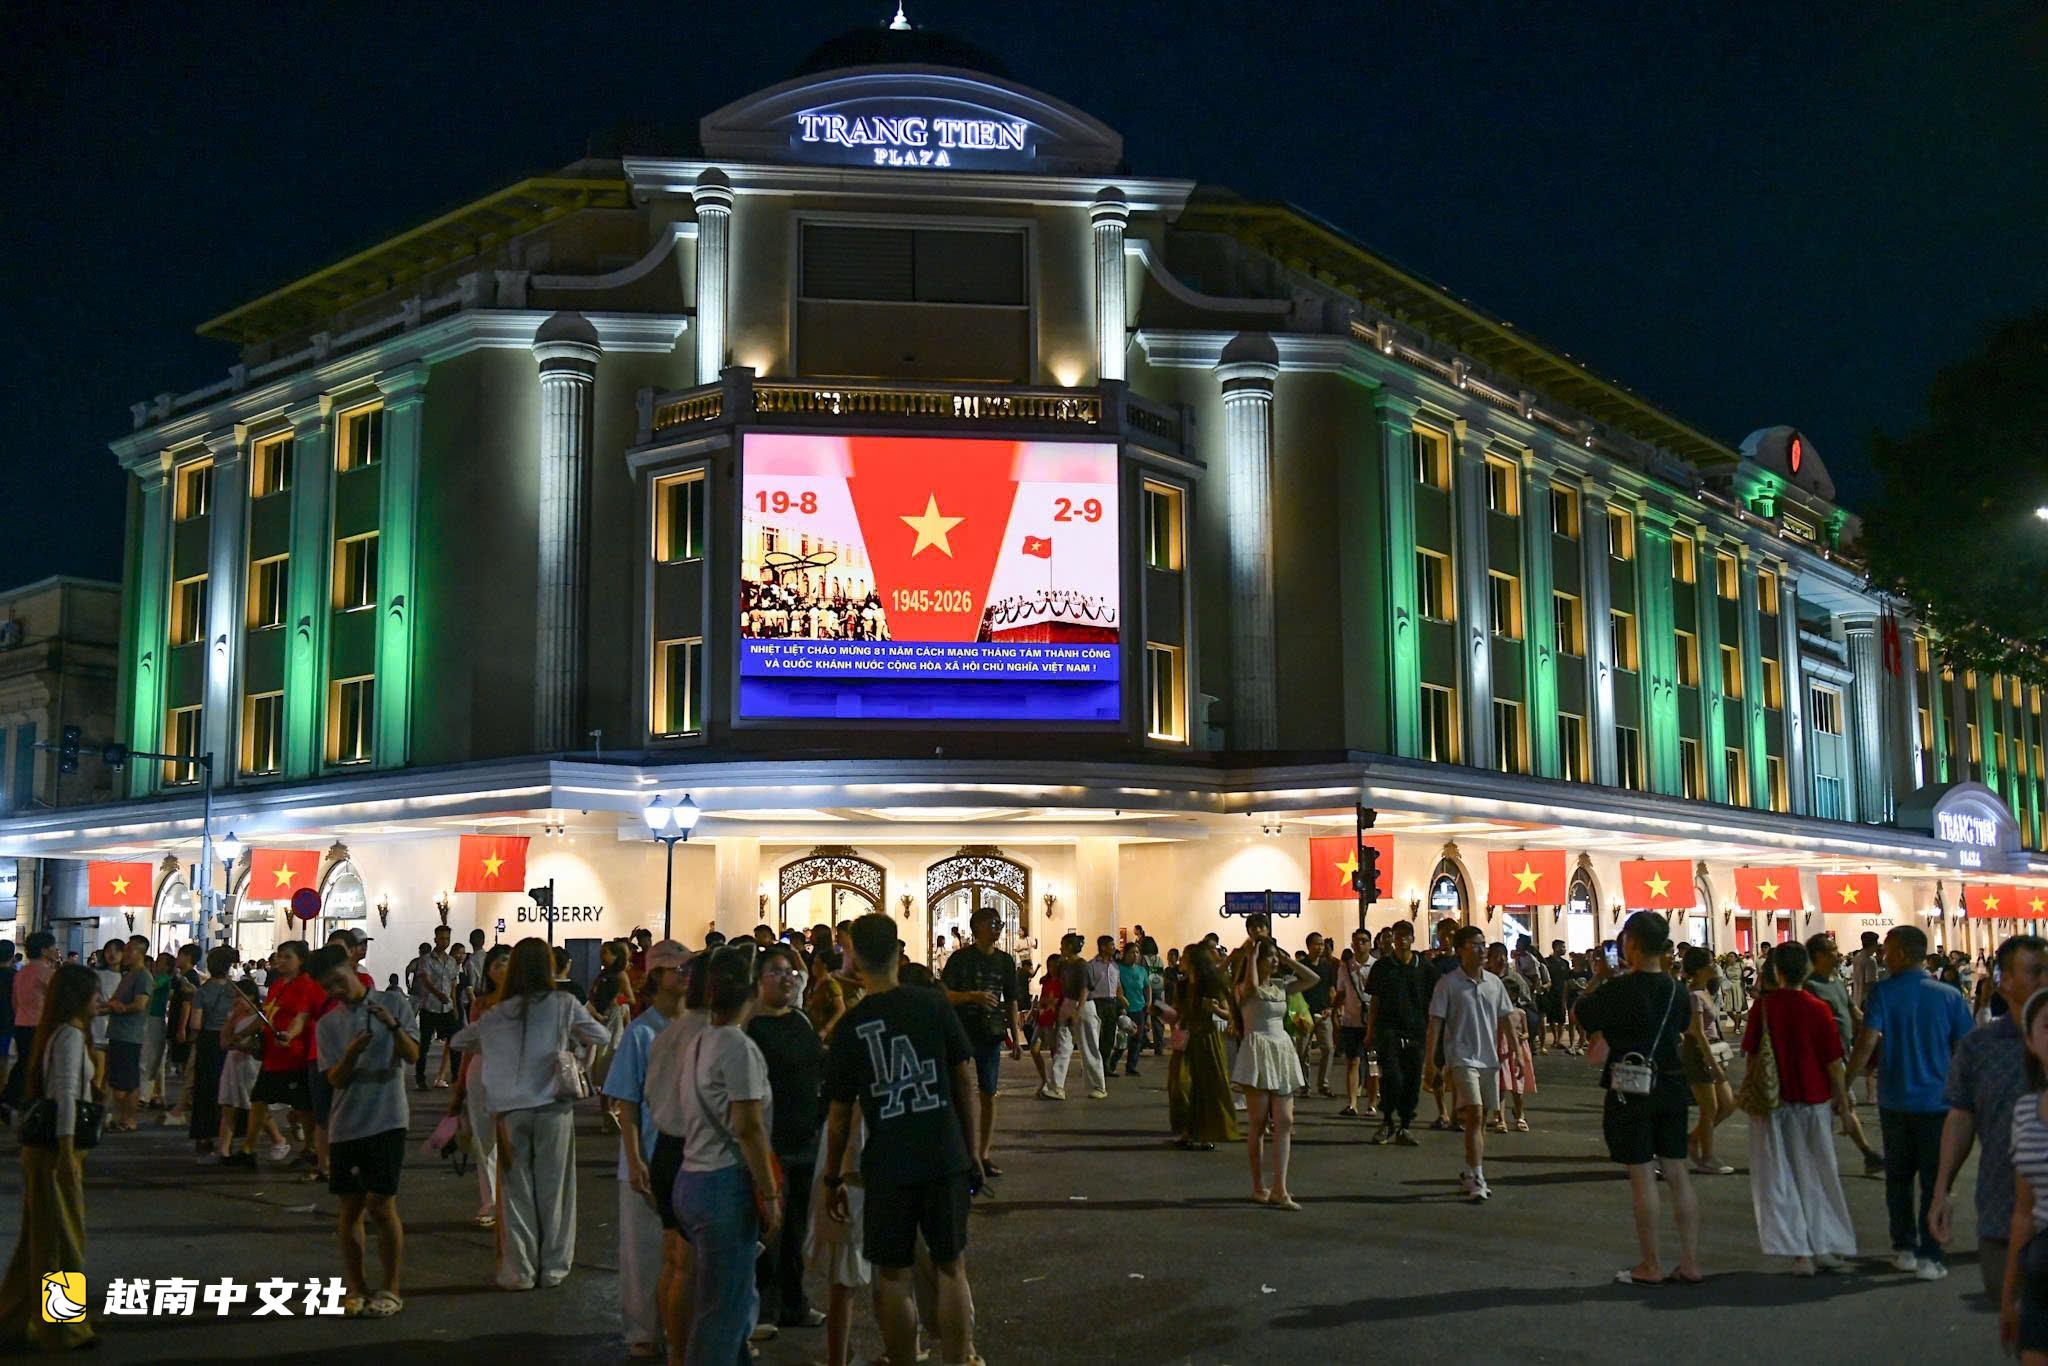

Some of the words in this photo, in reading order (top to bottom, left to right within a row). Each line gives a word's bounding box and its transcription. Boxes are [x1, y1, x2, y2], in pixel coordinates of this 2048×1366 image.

[798, 113, 927, 147] TRANG
[934, 119, 1027, 150] TIEN
[873, 148, 951, 167] PLAZA
[755, 490, 818, 515] 19-8
[1053, 497, 1103, 523] 2-9
[891, 589, 973, 613] 1945-2026
[751, 645, 780, 655] NHIỆT
[784, 645, 804, 656] LIỆT
[808, 645, 836, 655] CHÀO
[840, 646, 871, 655] MỪNG
[874, 647, 885, 655] 81
[889, 646, 913, 656] NĂM
[916, 646, 945, 656] CÁCH
[948, 648, 978, 658] MẠNG
[982, 647, 1016, 657] THÁNG
[1020, 648, 1042, 657] TÁM
[1045, 648, 1079, 658] THÀNH
[1082, 648, 1111, 658] CÔNG
[765, 659, 779, 668] VÀ
[783, 658, 812, 669] QUỐC
[816, 659, 852, 669] KHÁNH
[855, 660, 884, 670] NƯỚC
[888, 661, 917, 672] CỘNG
[920, 661, 941, 670] HÒA
[945, 661, 959, 670] XÃ
[963, 661, 980, 672] HỘI
[983, 660, 1003, 671] CHỦ
[1007, 662, 1039, 671] NGHĨA
[1042, 662, 1063, 673] VIỆT
[1066, 663, 1090, 672] NAM
[517, 906, 603, 922] BURBERRY
[1861, 918, 1894, 926] ROLEX
[855, 1019, 940, 1119] LA
